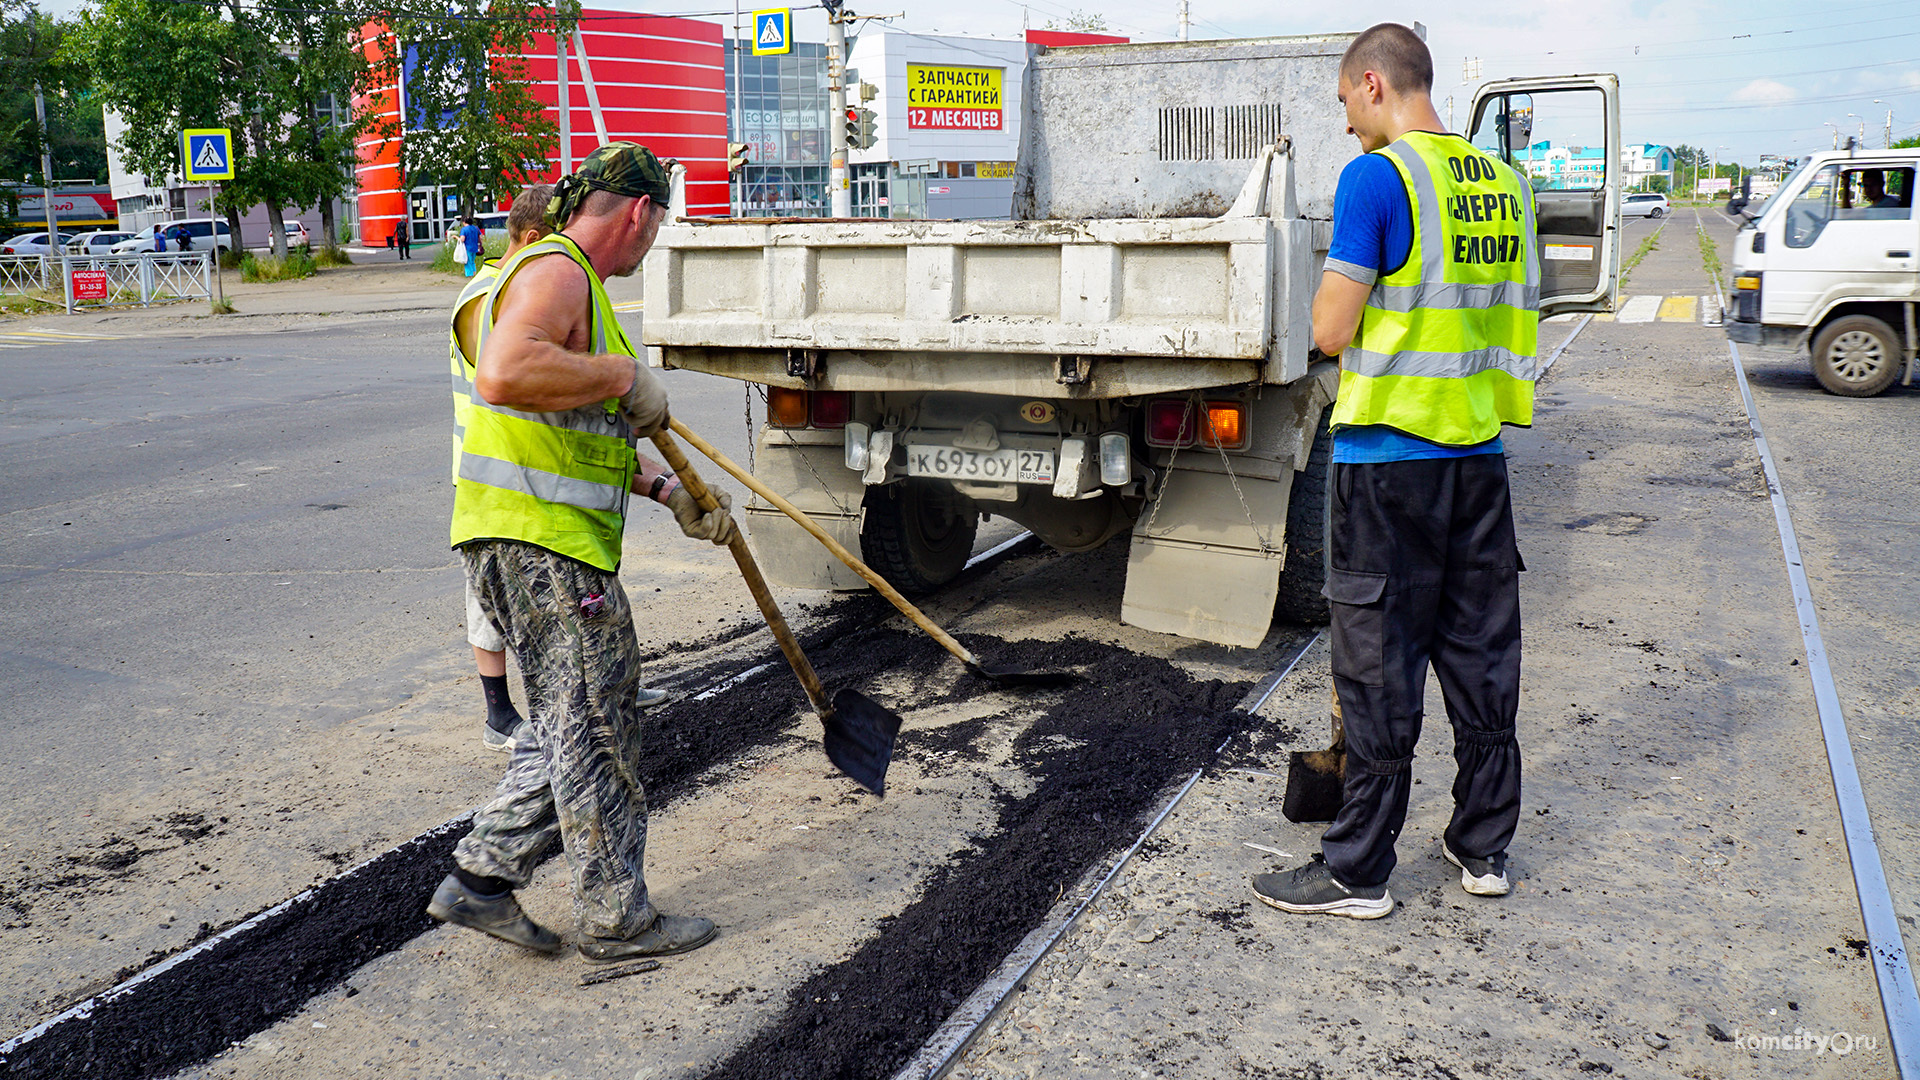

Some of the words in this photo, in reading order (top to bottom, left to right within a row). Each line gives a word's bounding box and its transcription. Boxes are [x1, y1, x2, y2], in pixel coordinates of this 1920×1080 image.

[918, 70, 989, 86] ЗАПЧАСТИ
[909, 88, 916, 102] С
[921, 87, 998, 104] ГАРАНТИЕЙ
[774, 112, 818, 124] Premum
[909, 110, 927, 126] 12
[931, 110, 999, 129] МЕСЯЦЕВ
[1448, 155, 1497, 183] ООО
[917, 449, 1013, 478] К693ОУ
[1020, 452, 1044, 472] 27
[1019, 472, 1038, 480] RUS
